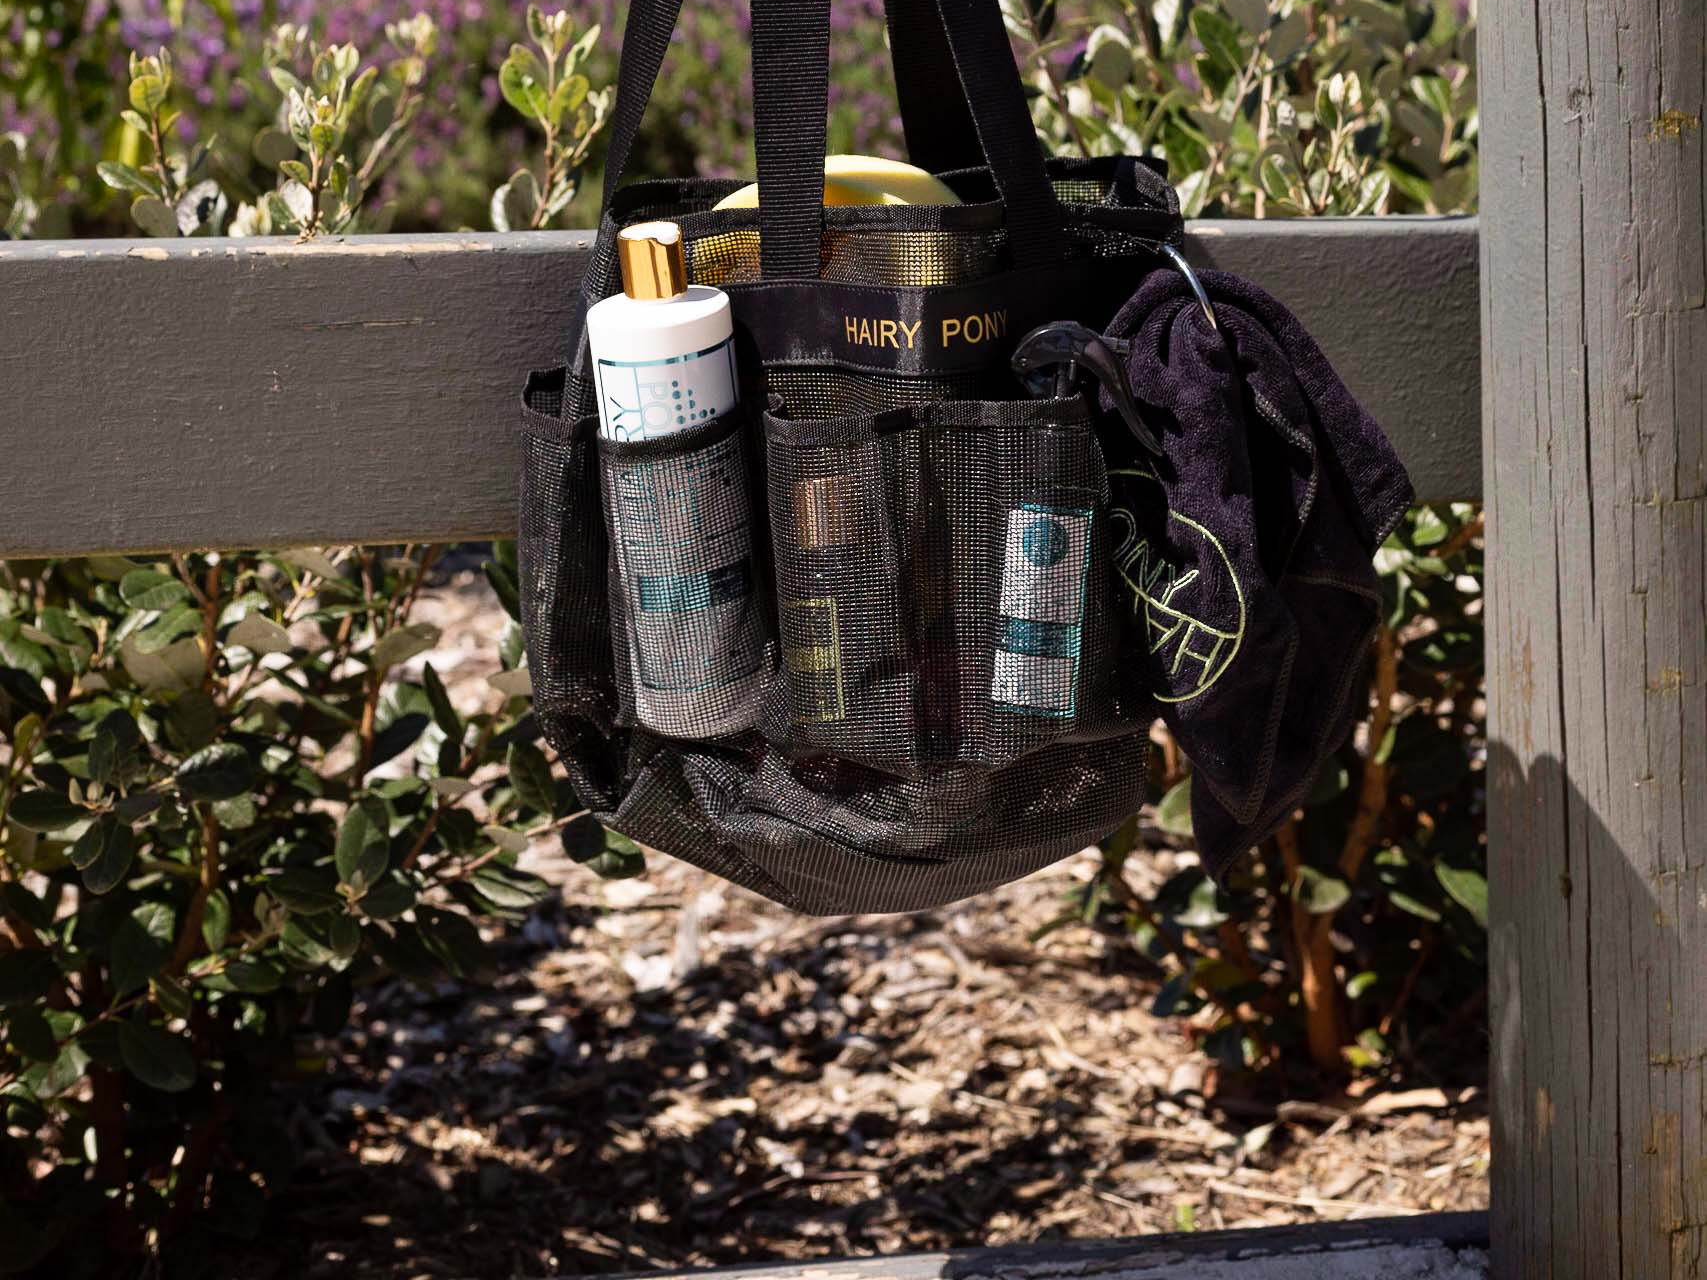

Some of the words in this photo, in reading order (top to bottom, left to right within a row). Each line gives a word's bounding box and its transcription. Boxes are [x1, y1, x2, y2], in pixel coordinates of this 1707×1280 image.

[845, 316, 922, 349] HAIRY
[942, 309, 1007, 347] PONY
[1109, 508, 1199, 606] ONY
